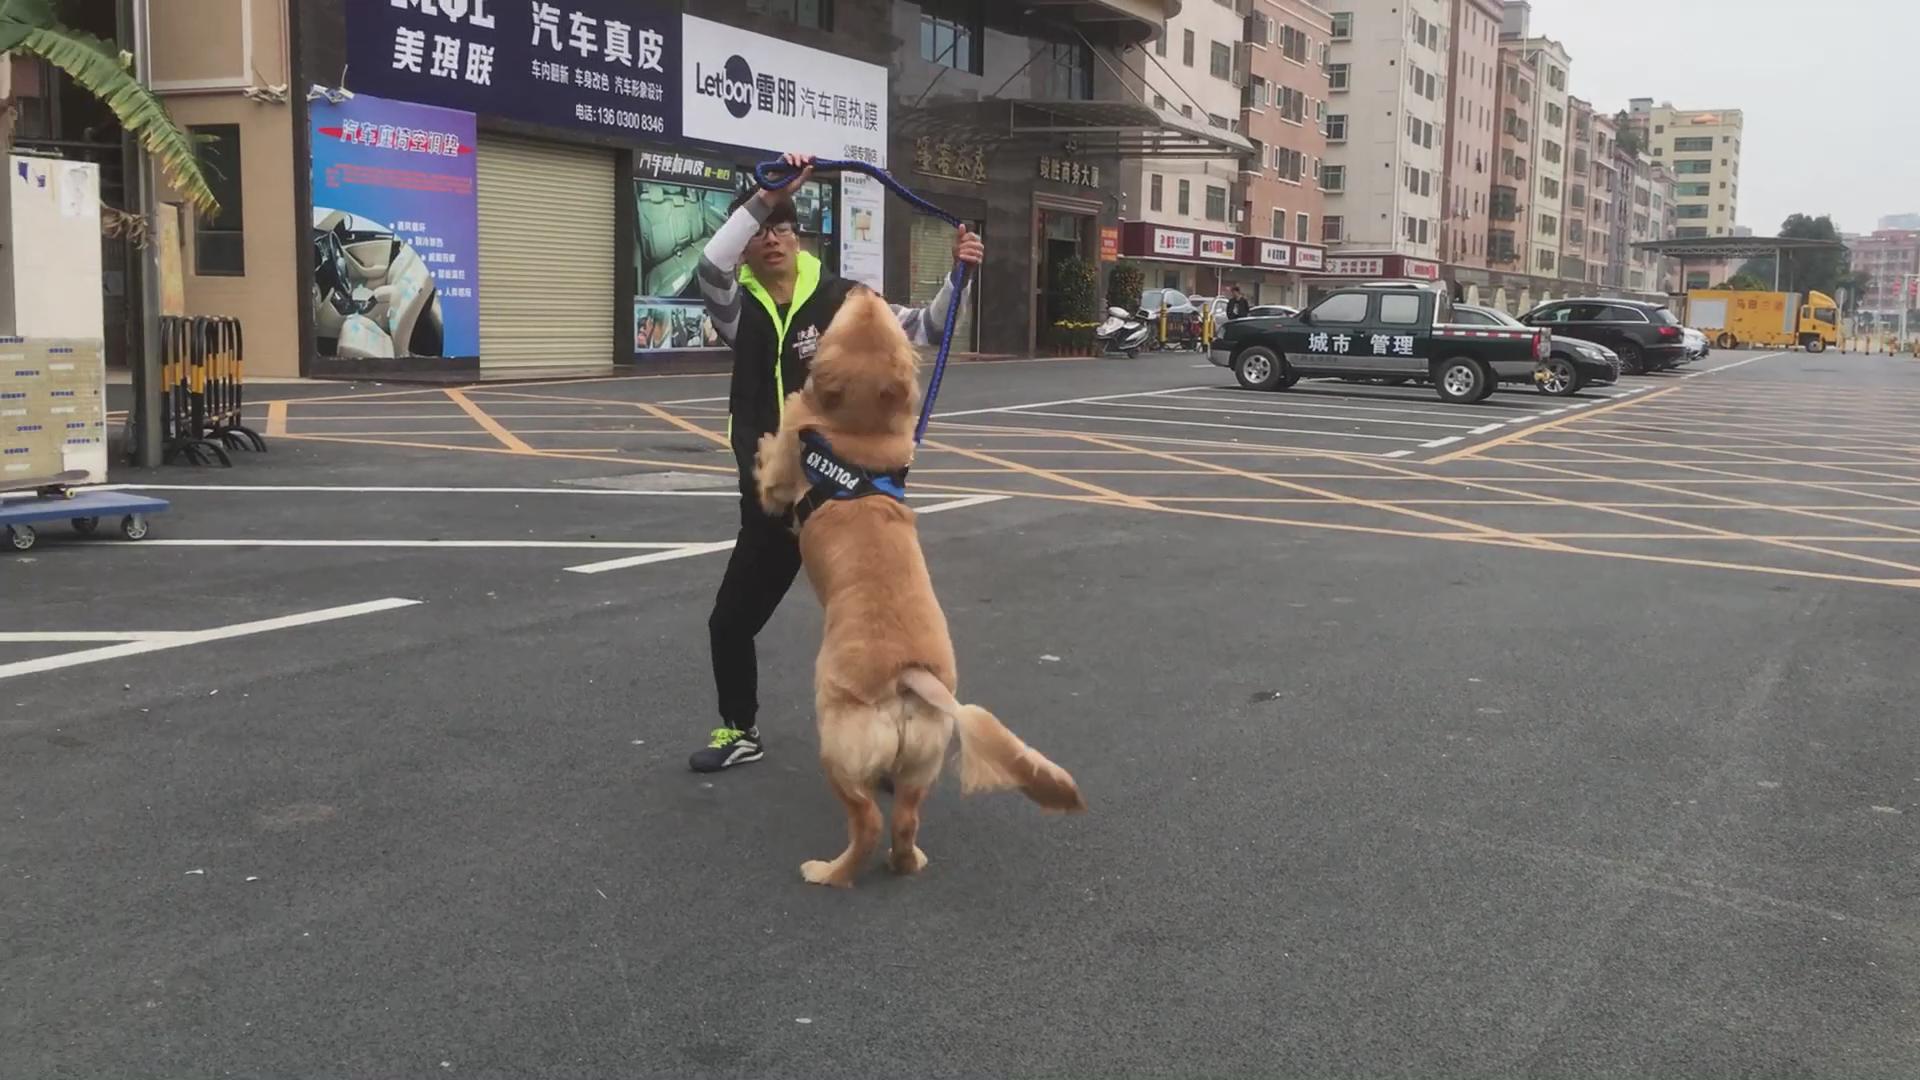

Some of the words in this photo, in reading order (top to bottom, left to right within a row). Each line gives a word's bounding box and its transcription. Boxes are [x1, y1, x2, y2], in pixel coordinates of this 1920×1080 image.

[392, 26, 495, 86] 美琪联
[531, 0, 664, 73] 汽车真皮
[531, 58, 569, 85] 车内翻新
[574, 68, 610, 92] 车身改色
[614, 76, 664, 102] 汽车形象设计
[696, 61, 753, 104] Letbon
[616, 111, 640, 129] 0300
[641, 114, 664, 133] 8346
[756, 72, 796, 118] 雷朋
[800, 87, 878, 132] 汽车隔热膜
[340, 119, 460, 157] 汽车座椅空调垫
[1308, 332, 1352, 354] 城市
[1370, 334, 1414, 356] 管理
[806, 451, 823, 468] K9
[819, 459, 860, 490] POLICE
